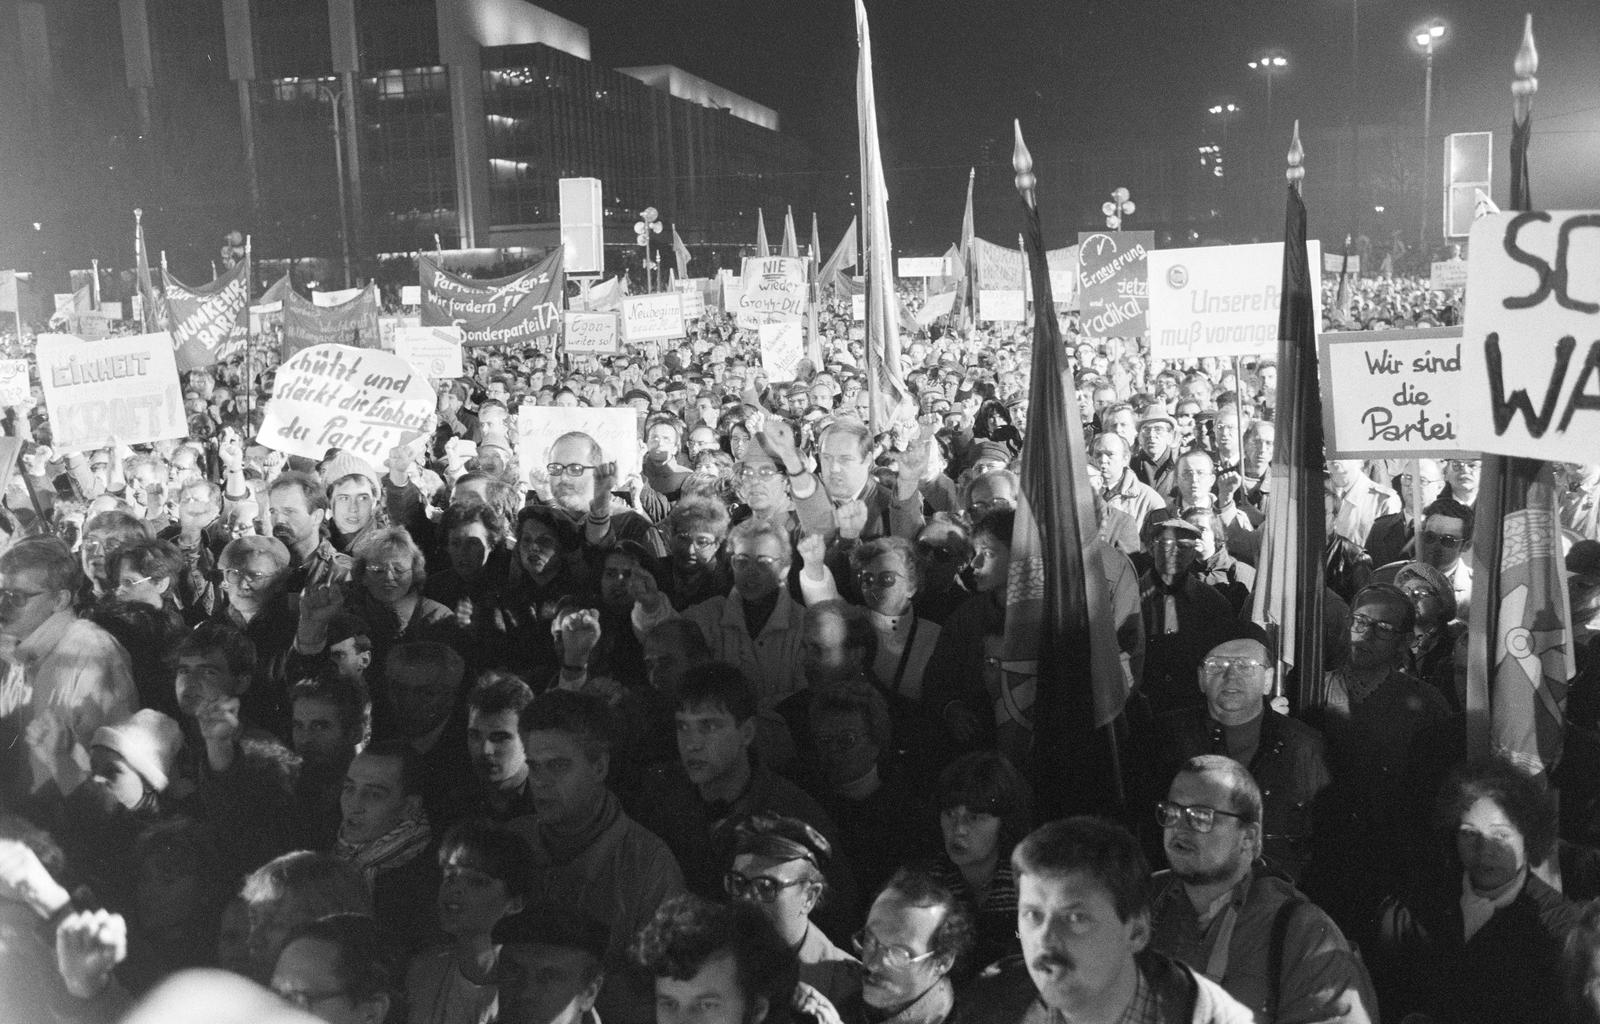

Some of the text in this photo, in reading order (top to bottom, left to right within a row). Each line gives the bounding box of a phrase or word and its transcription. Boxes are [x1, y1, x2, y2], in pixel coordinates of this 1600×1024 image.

[763, 259, 787, 274] NIE
[1080, 243, 1147, 288] Erneuerung
[428, 289, 447, 307] Wir
[447, 297, 497, 317] fordern
[1191, 284, 1281, 314] Unsere Pa
[1082, 295, 1144, 337] radikal
[568, 333, 614, 346] weiter so!
[1160, 320, 1278, 352] muß vorange
[1365, 343, 1461, 375] Wir sind
[364, 374, 412, 394] und
[1392, 382, 1432, 407] die
[276, 376, 432, 428] stärkt die Einheit
[277, 415, 390, 456] der Partei
[1361, 406, 1457, 442] Partei
